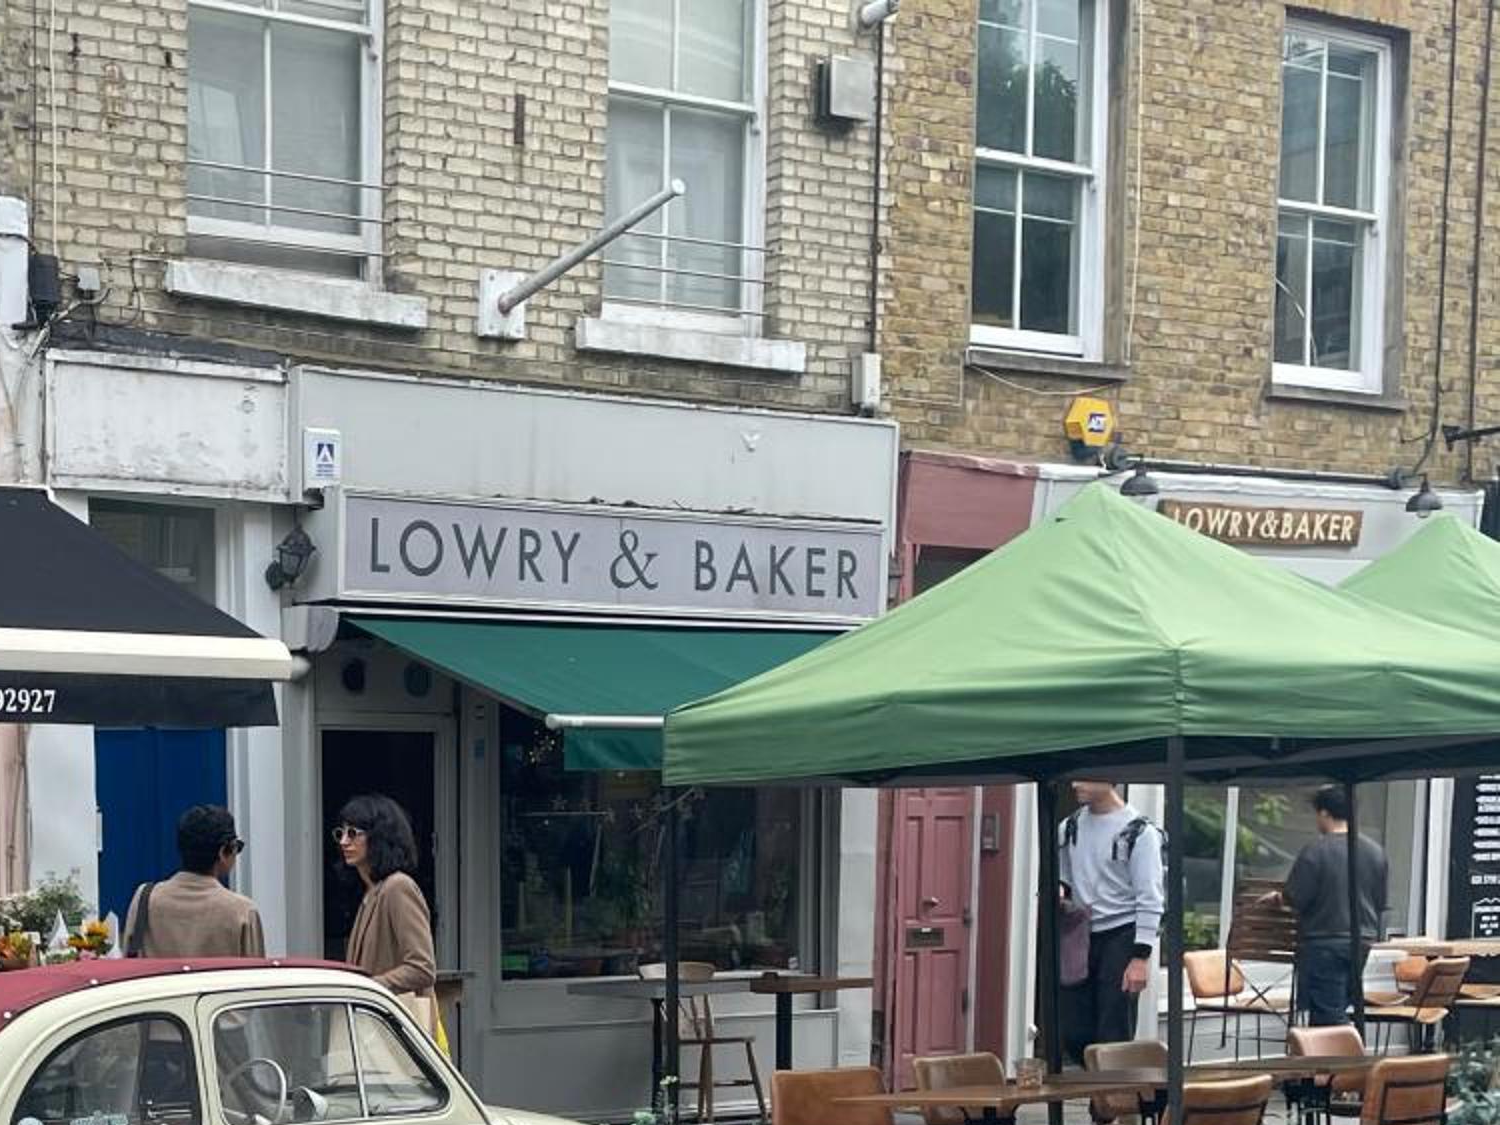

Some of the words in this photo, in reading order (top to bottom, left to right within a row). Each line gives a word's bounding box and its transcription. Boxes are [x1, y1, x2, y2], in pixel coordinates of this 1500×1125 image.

[370, 517, 581, 584] LOWRY
[609, 530, 660, 591] &
[694, 540, 858, 599] BAKER
